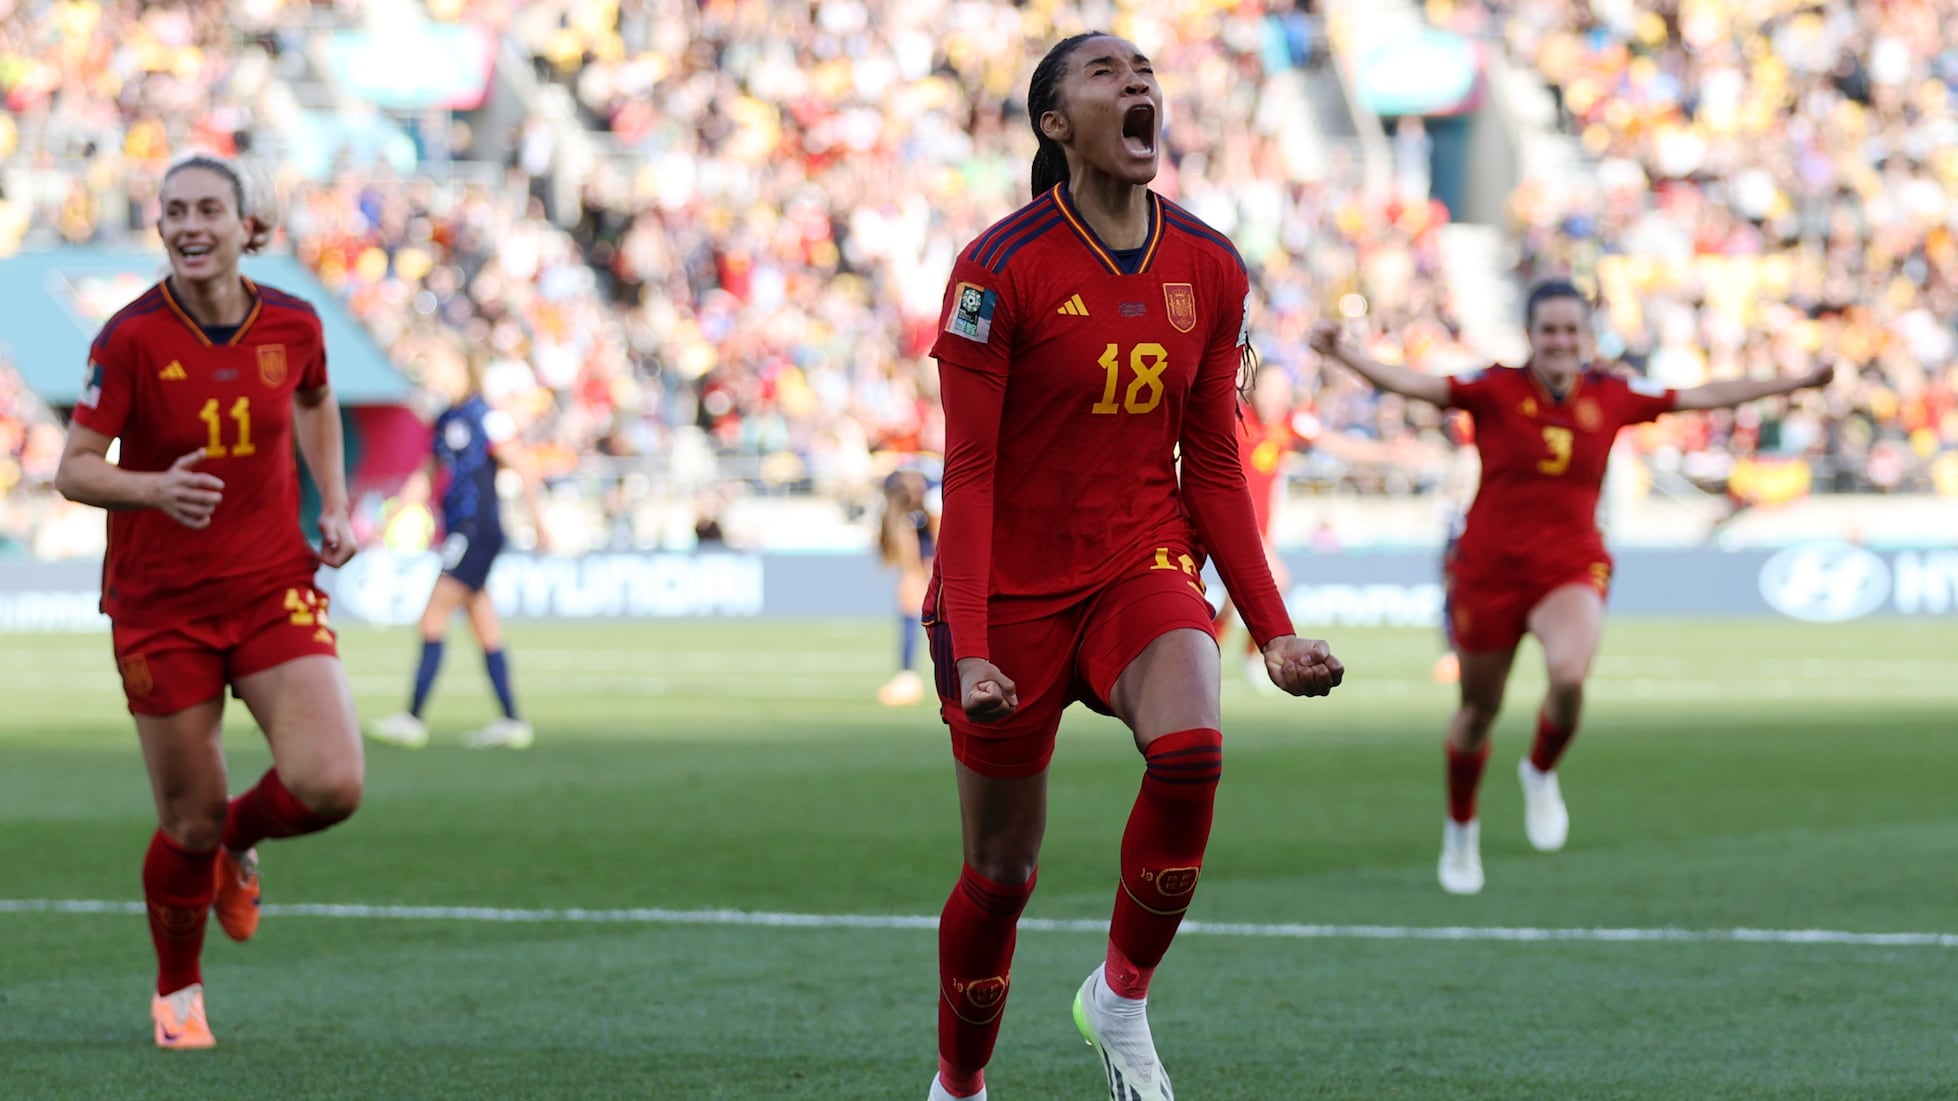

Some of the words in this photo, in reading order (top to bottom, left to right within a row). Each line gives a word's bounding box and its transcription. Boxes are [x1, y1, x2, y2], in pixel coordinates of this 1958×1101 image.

[1092, 342, 1169, 415] 18
[198, 396, 256, 458] 11
[1537, 425, 1574, 476] 3
